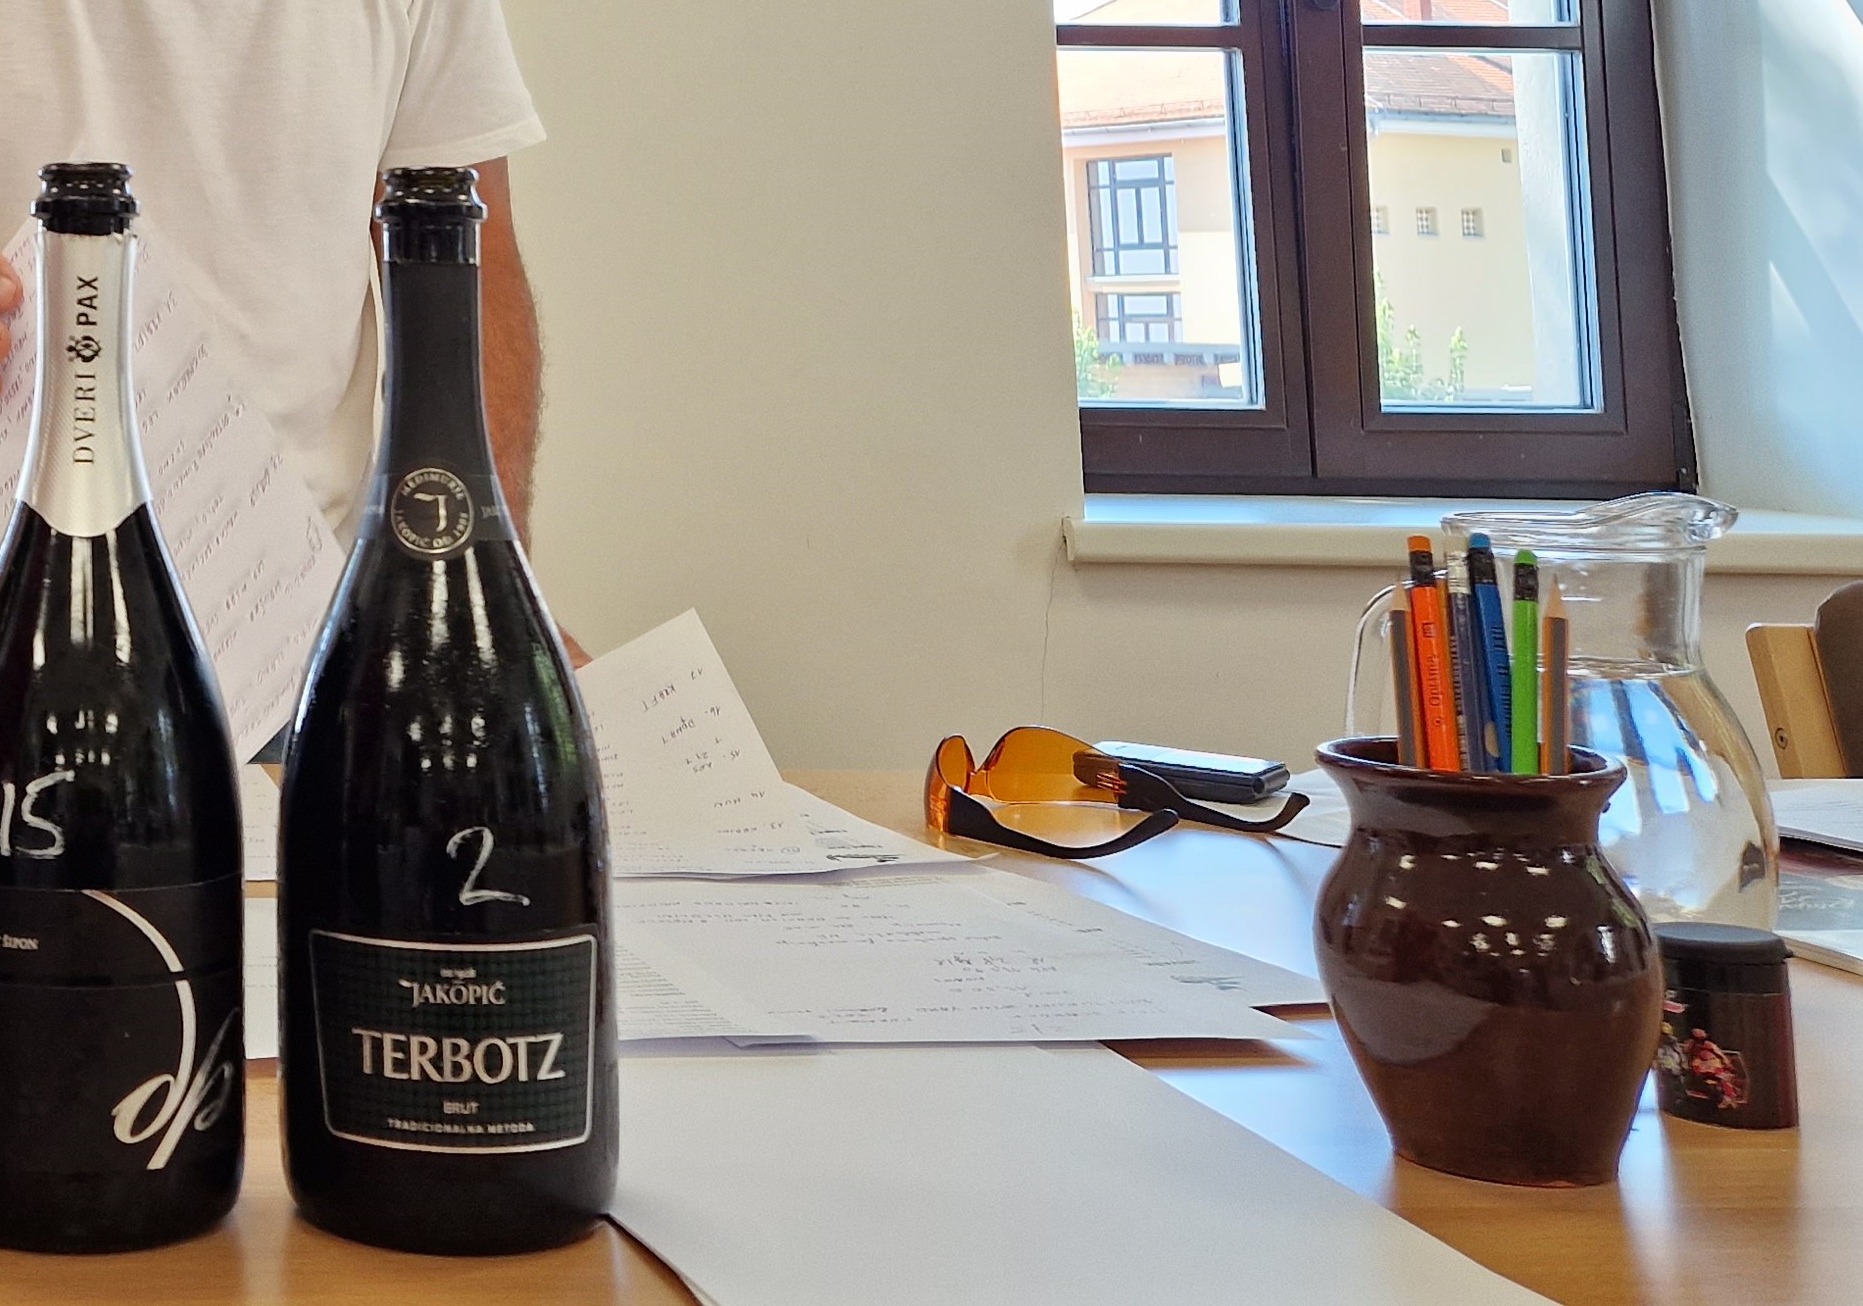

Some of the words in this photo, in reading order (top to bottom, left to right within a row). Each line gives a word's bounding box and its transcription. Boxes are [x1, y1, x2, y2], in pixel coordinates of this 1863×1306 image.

[77, 275, 99, 328] PAX
[73, 373, 97, 466] DVERI
[0, 769, 77, 860] 15
[445, 825, 531, 907] 2
[351, 1026, 567, 1084] TERBOTZ
[387, 1118, 485, 1134] TRADICIONALNA
[487, 1122, 536, 1135] METODA
[443, 1101, 481, 1115] BRUT
